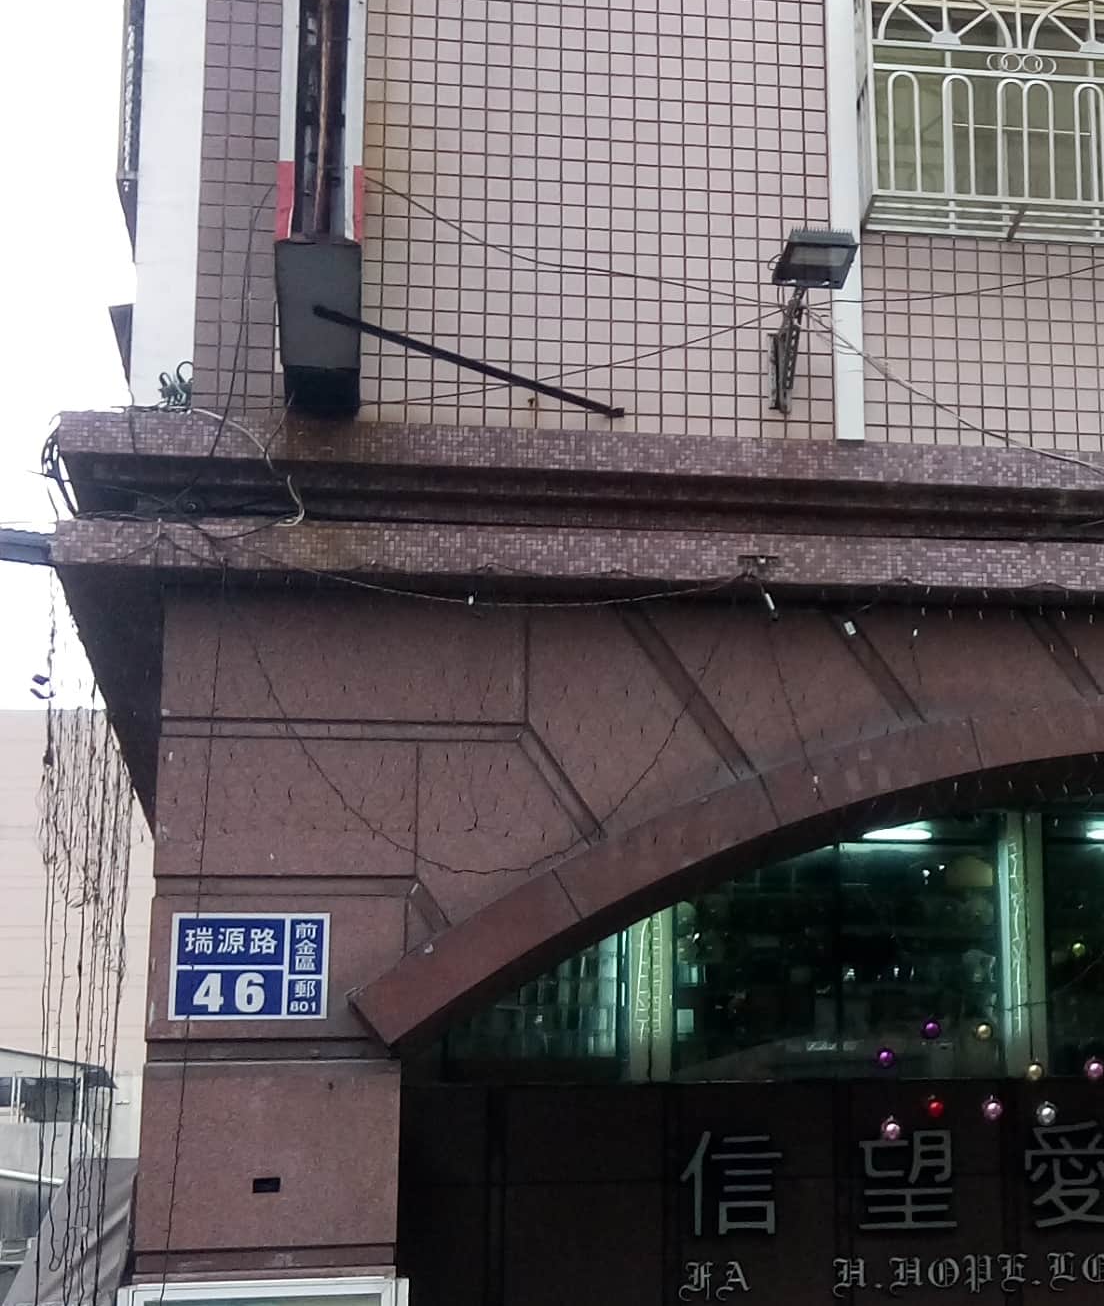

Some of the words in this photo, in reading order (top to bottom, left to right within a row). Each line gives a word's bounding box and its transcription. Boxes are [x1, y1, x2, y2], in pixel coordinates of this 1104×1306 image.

[185, 927, 278, 955] 瑞源路
[295, 922, 318, 971] 前金區
[193, 972, 265, 1013] 46
[294, 980, 316, 998] 郵
[289, 1001, 316, 1012] 801
